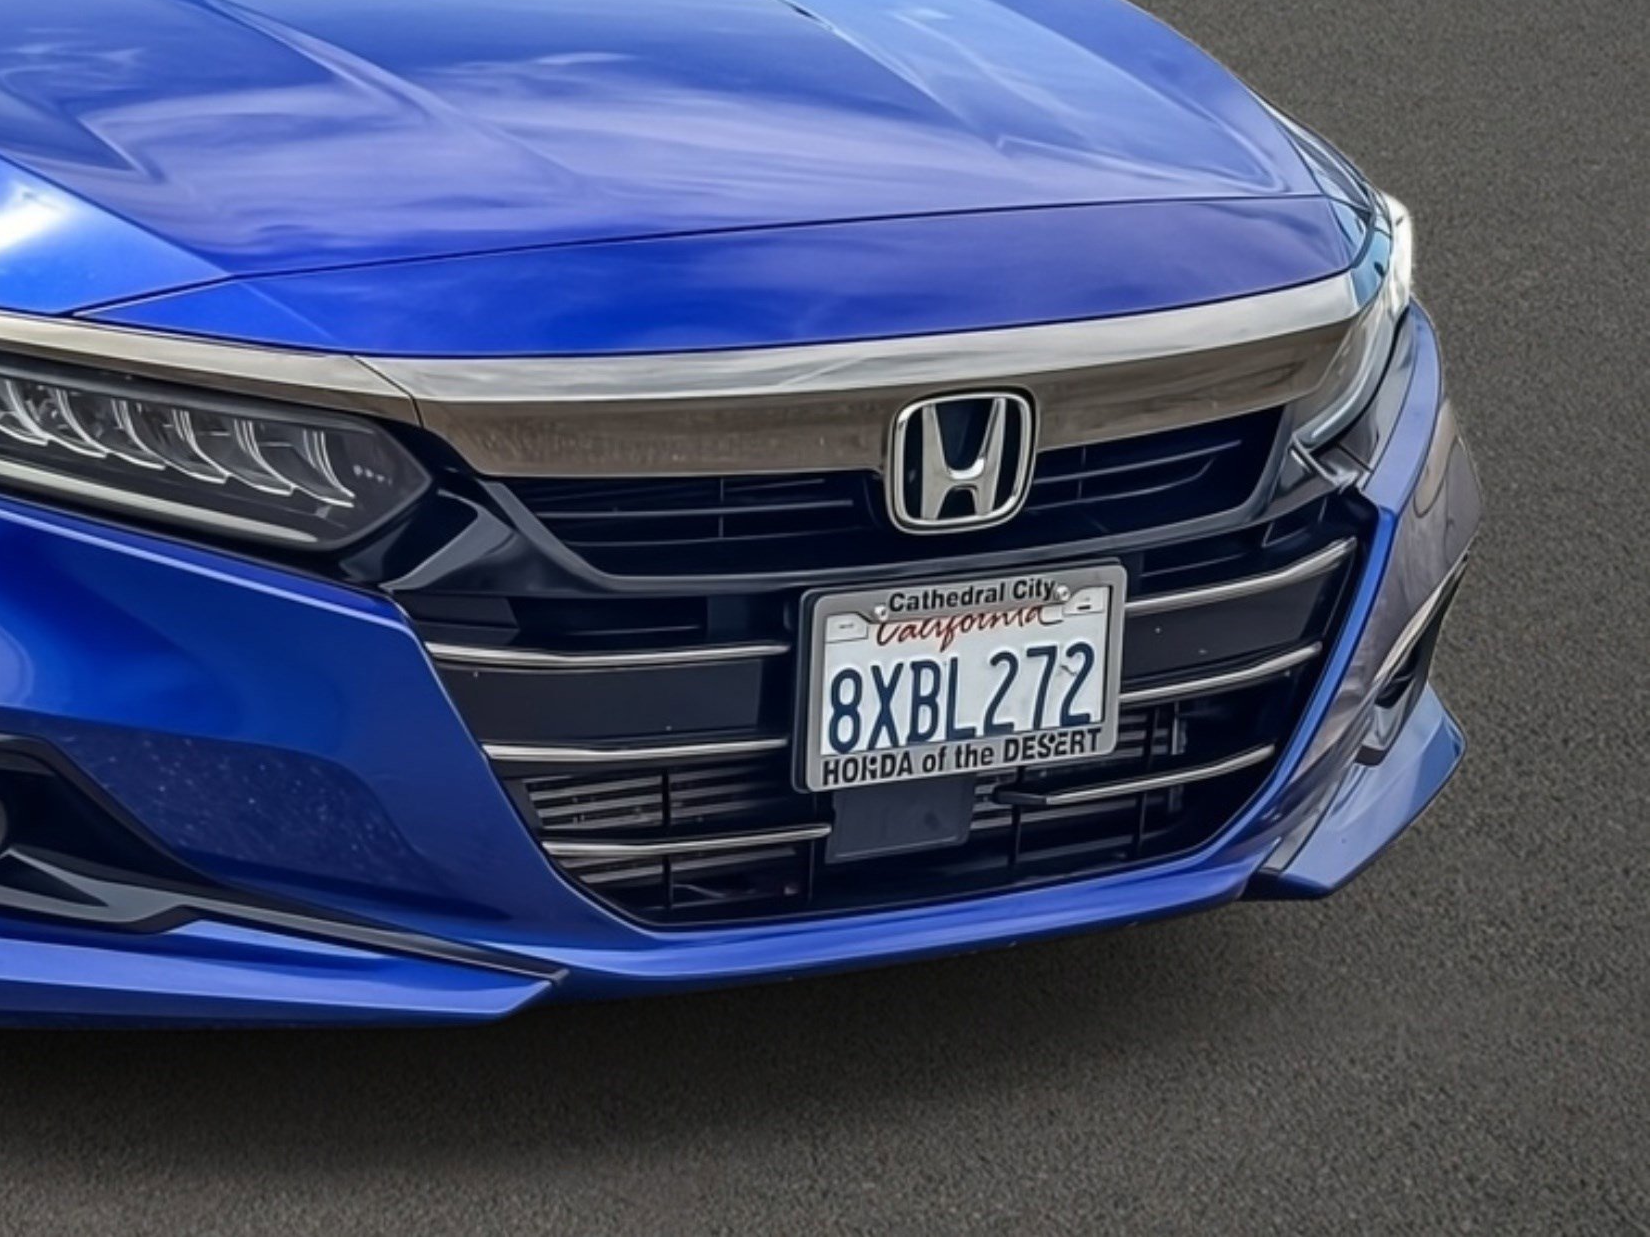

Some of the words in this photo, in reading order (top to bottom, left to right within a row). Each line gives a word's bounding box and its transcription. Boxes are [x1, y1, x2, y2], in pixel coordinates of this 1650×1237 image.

[888, 581, 1006, 613] Cathedral
[1012, 578, 1056, 602] City
[827, 641, 1095, 755] 8XBL272
[822, 751, 914, 786] HONDA
[922, 746, 947, 773] of
[954, 742, 994, 768] the
[1003, 728, 1102, 763] DESERT
